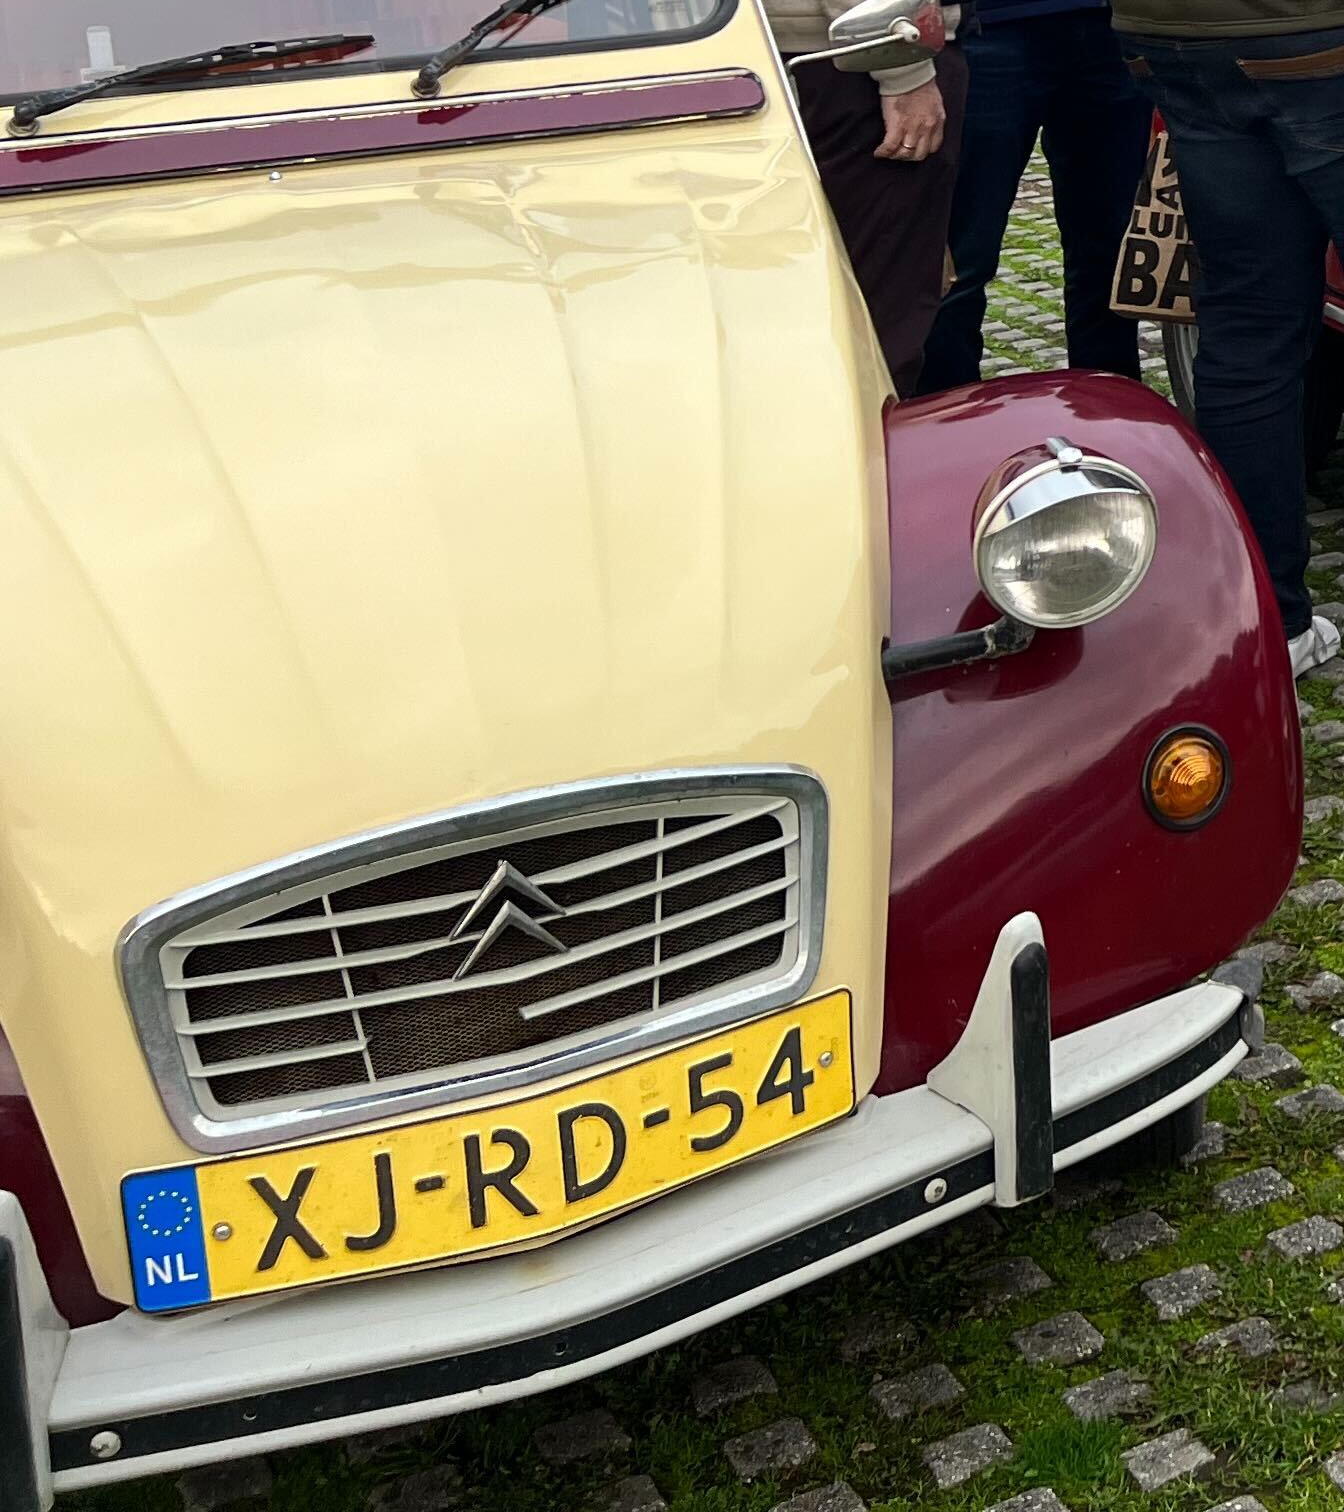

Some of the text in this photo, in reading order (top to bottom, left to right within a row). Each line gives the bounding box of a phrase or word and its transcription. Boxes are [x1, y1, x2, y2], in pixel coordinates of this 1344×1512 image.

[1117, 237, 1197, 309] BA
[249, 1027, 815, 1271] XJ-RD-54
[146, 1254, 198, 1286] NL
